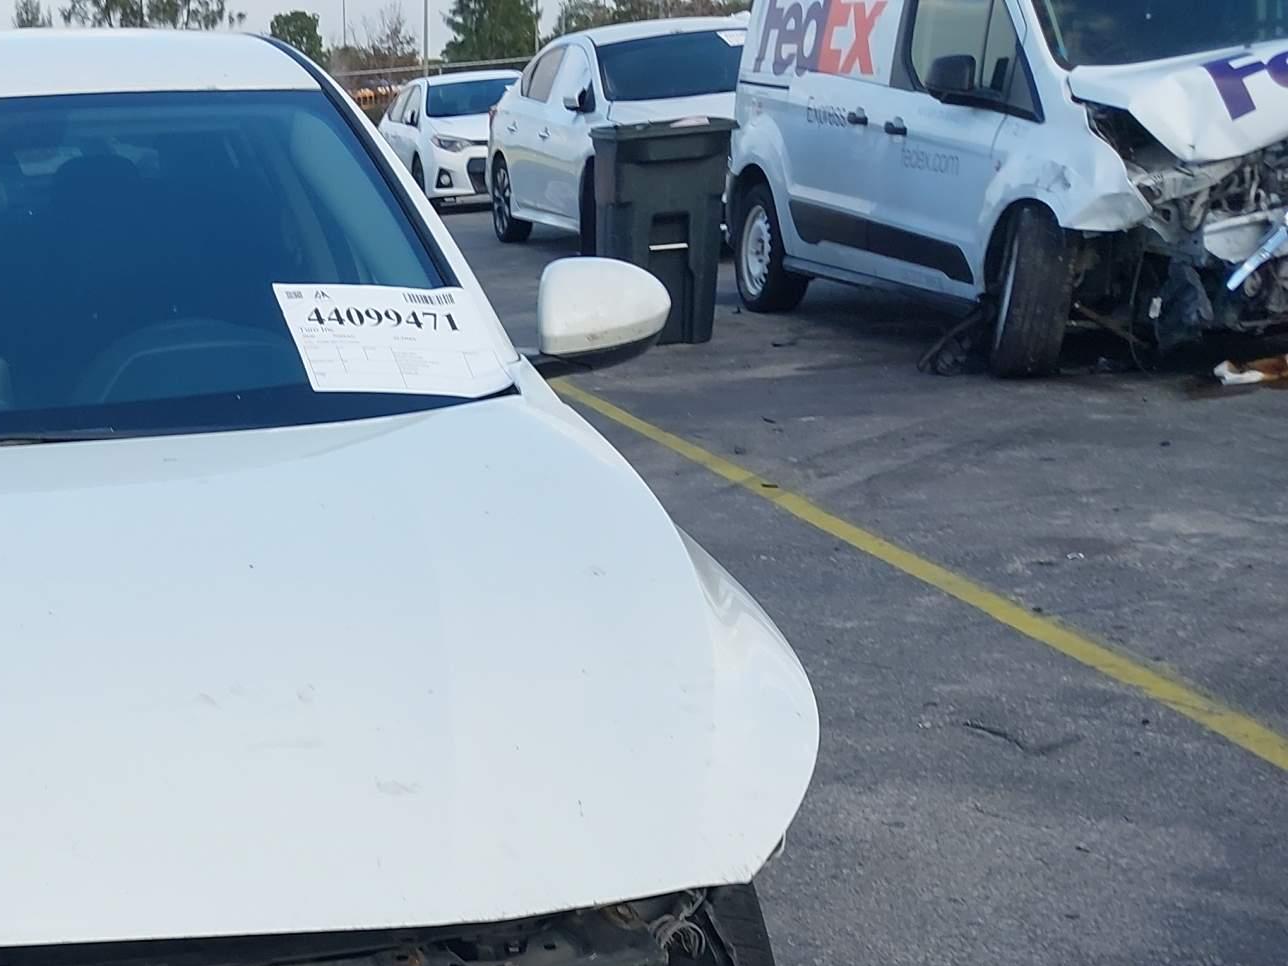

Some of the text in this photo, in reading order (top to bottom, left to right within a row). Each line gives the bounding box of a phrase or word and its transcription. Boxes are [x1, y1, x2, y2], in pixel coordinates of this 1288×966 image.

[753, 0, 888, 77] FedEx
[806, 97, 847, 129] Express
[902, 142, 960, 176] fedex.com
[307, 307, 459, 331] 44099471
